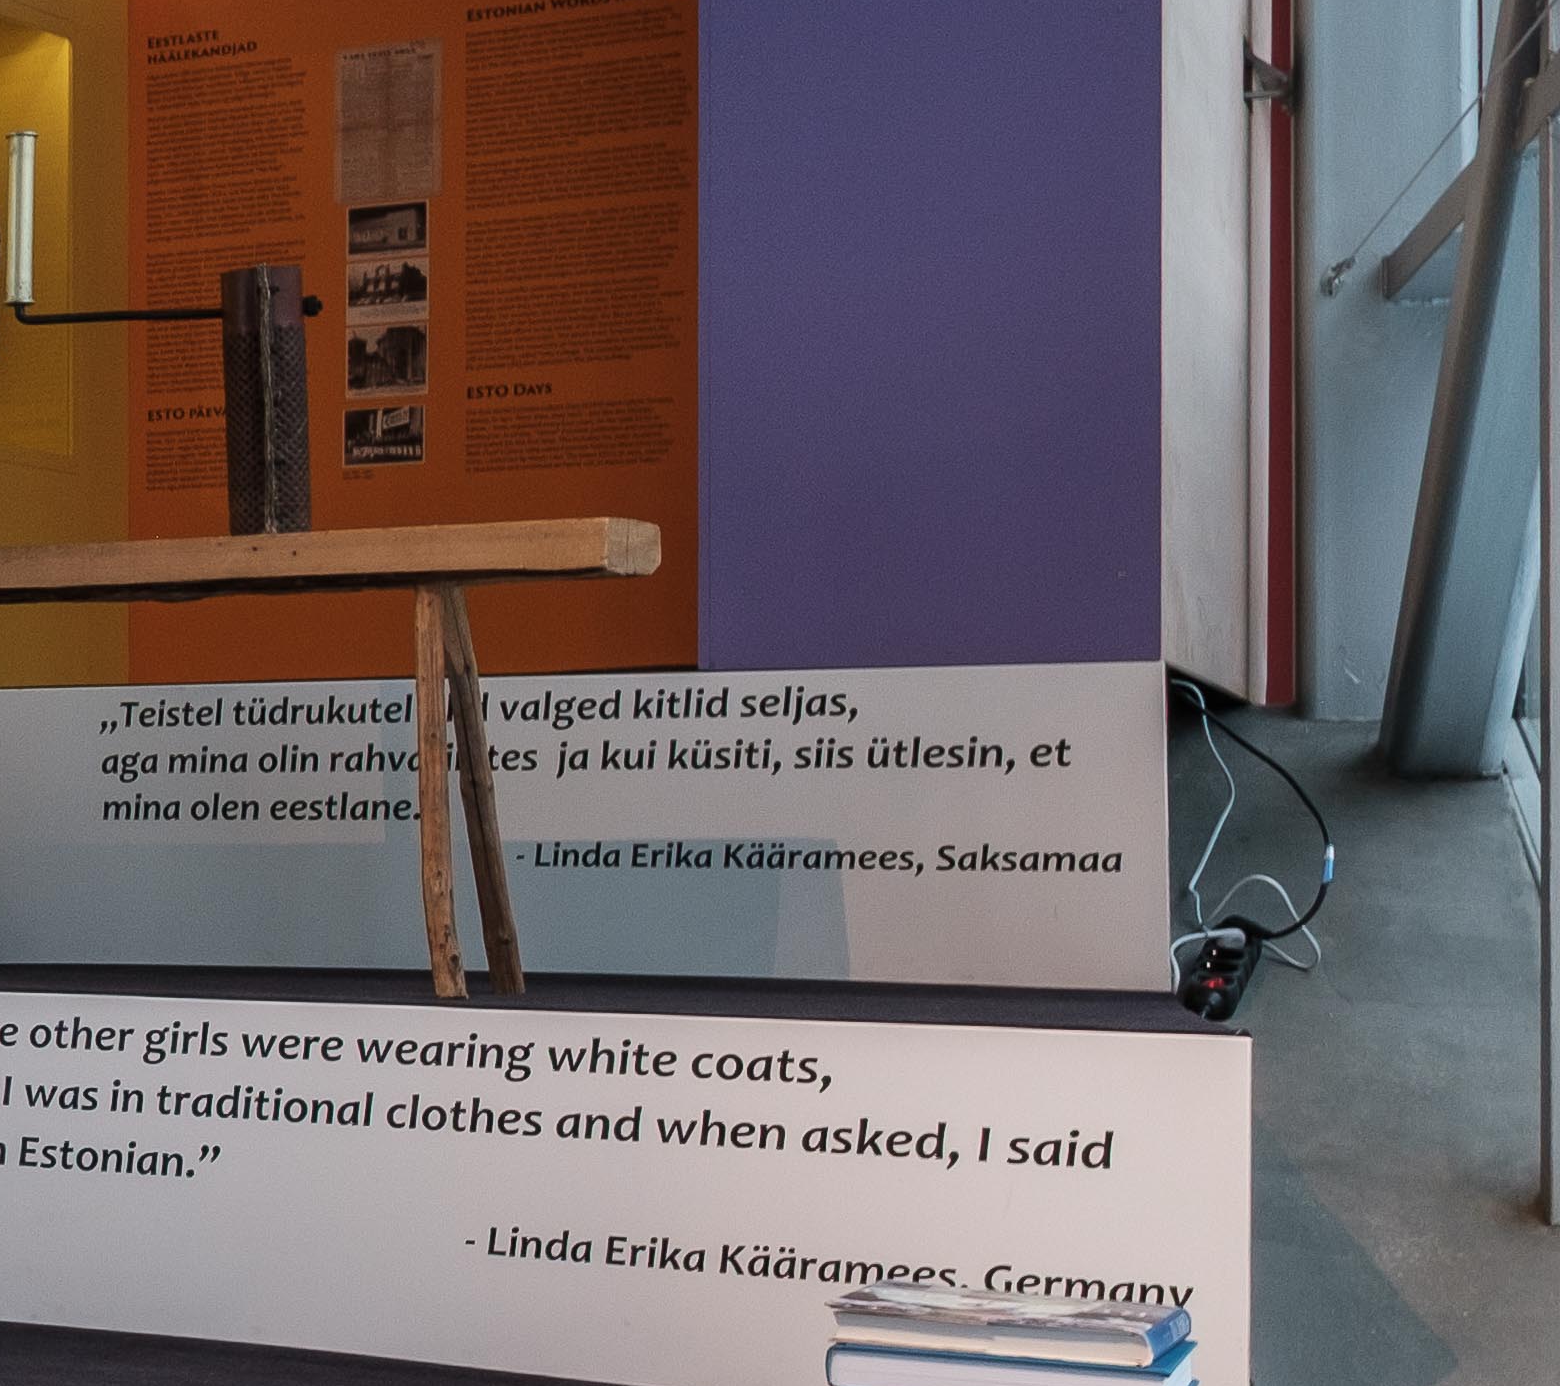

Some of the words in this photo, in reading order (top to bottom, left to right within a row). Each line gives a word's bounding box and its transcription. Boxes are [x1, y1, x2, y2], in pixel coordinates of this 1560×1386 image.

[232, 691, 413, 729] tüdrukutel
[500, 689, 621, 730] valged
[633, 687, 729, 719] kitlid
[740, 686, 857, 725] seljas,
[101, 751, 159, 783] aga
[167, 743, 250, 777] mina
[257, 744, 319, 775] olin
[556, 741, 589, 779] ja
[601, 740, 657, 770] kui
[668, 738, 781, 775] küsiti,
[794, 737, 853, 769] siis
[867, 736, 1015, 775] ütlesin,
[1030, 739, 1071, 767] et
[103, 793, 180, 820] mina
[191, 792, 259, 821] olen
[270, 792, 422, 823] eestlane.
[535, 841, 620, 867] Linda
[631, 842, 712, 868] Erika
[724, 842, 924, 877] Kääramees,
[936, 843, 1122, 873] Saksamaa
[30, 1017, 135, 1051] other
[143, 1021, 228, 1064] girls
[242, 1034, 343, 1061] were
[357, 1033, 535, 1082] wearing
[548, 1037, 677, 1077] white
[692, 1050, 831, 1093] coats,
[488, 1227, 592, 1263] Linda
[606, 1236, 705, 1272] Erika
